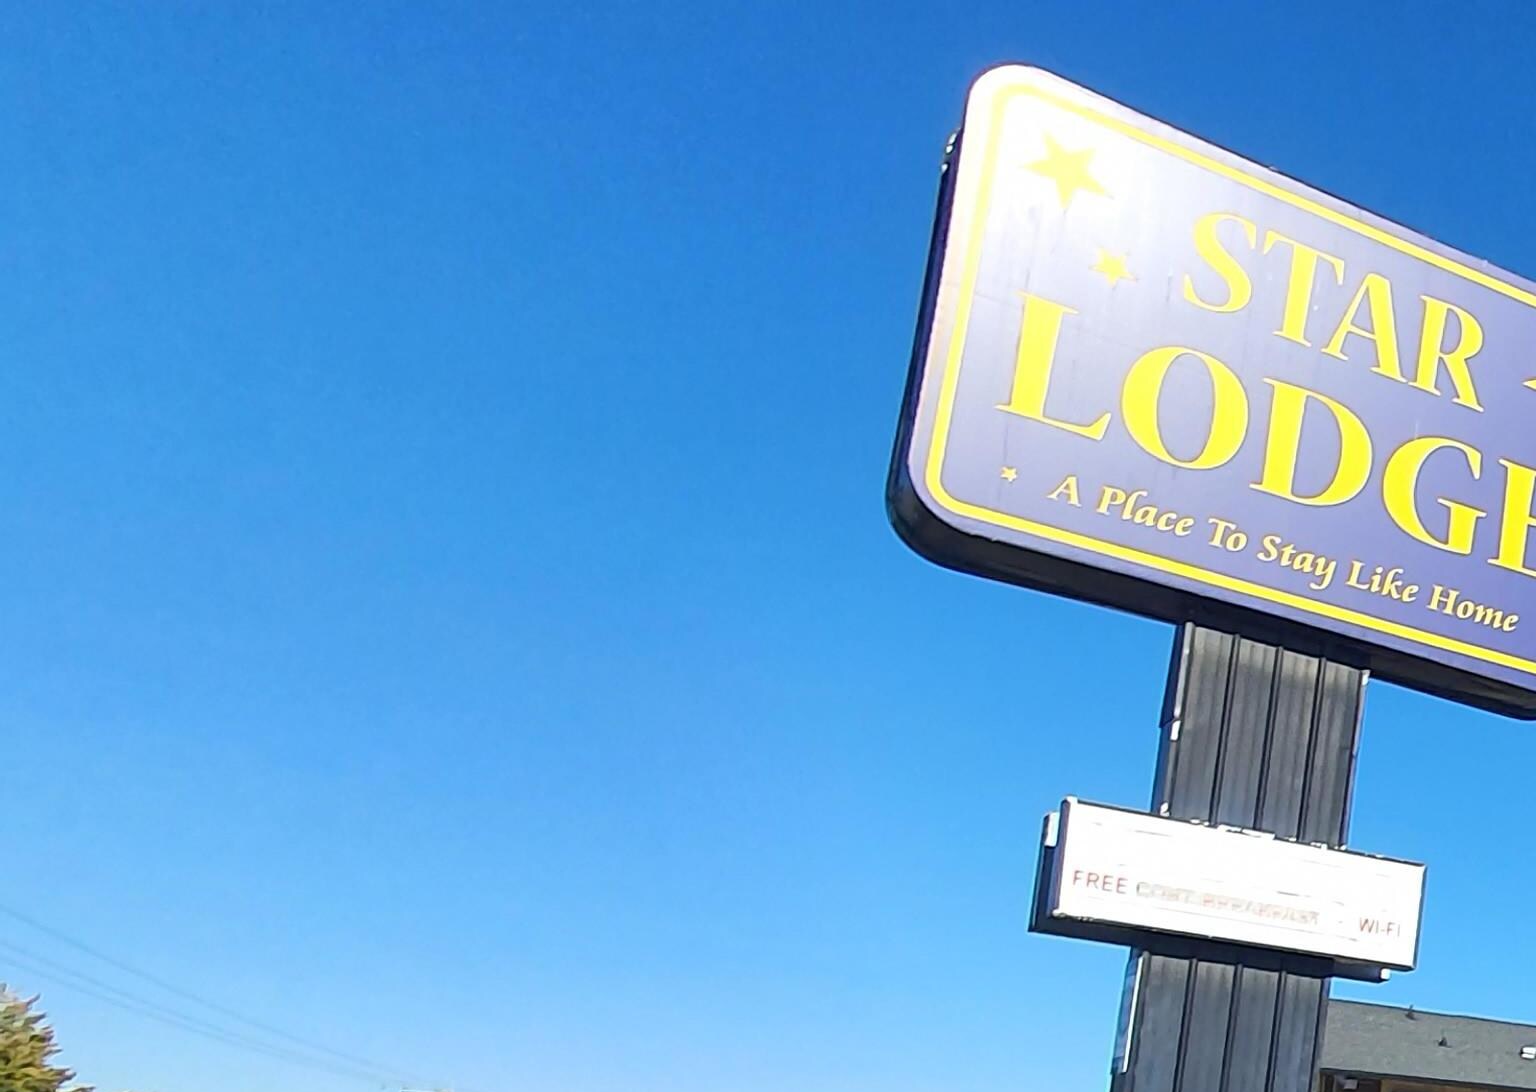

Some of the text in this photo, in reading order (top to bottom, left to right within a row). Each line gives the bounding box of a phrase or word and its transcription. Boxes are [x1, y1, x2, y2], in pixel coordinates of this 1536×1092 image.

[1183, 212, 1485, 413] STAR
[1048, 474, 1520, 633] A Place To Stay Like Home
[1072, 869, 1128, 896] FREE
[1359, 917, 1401, 938] WI-FI
